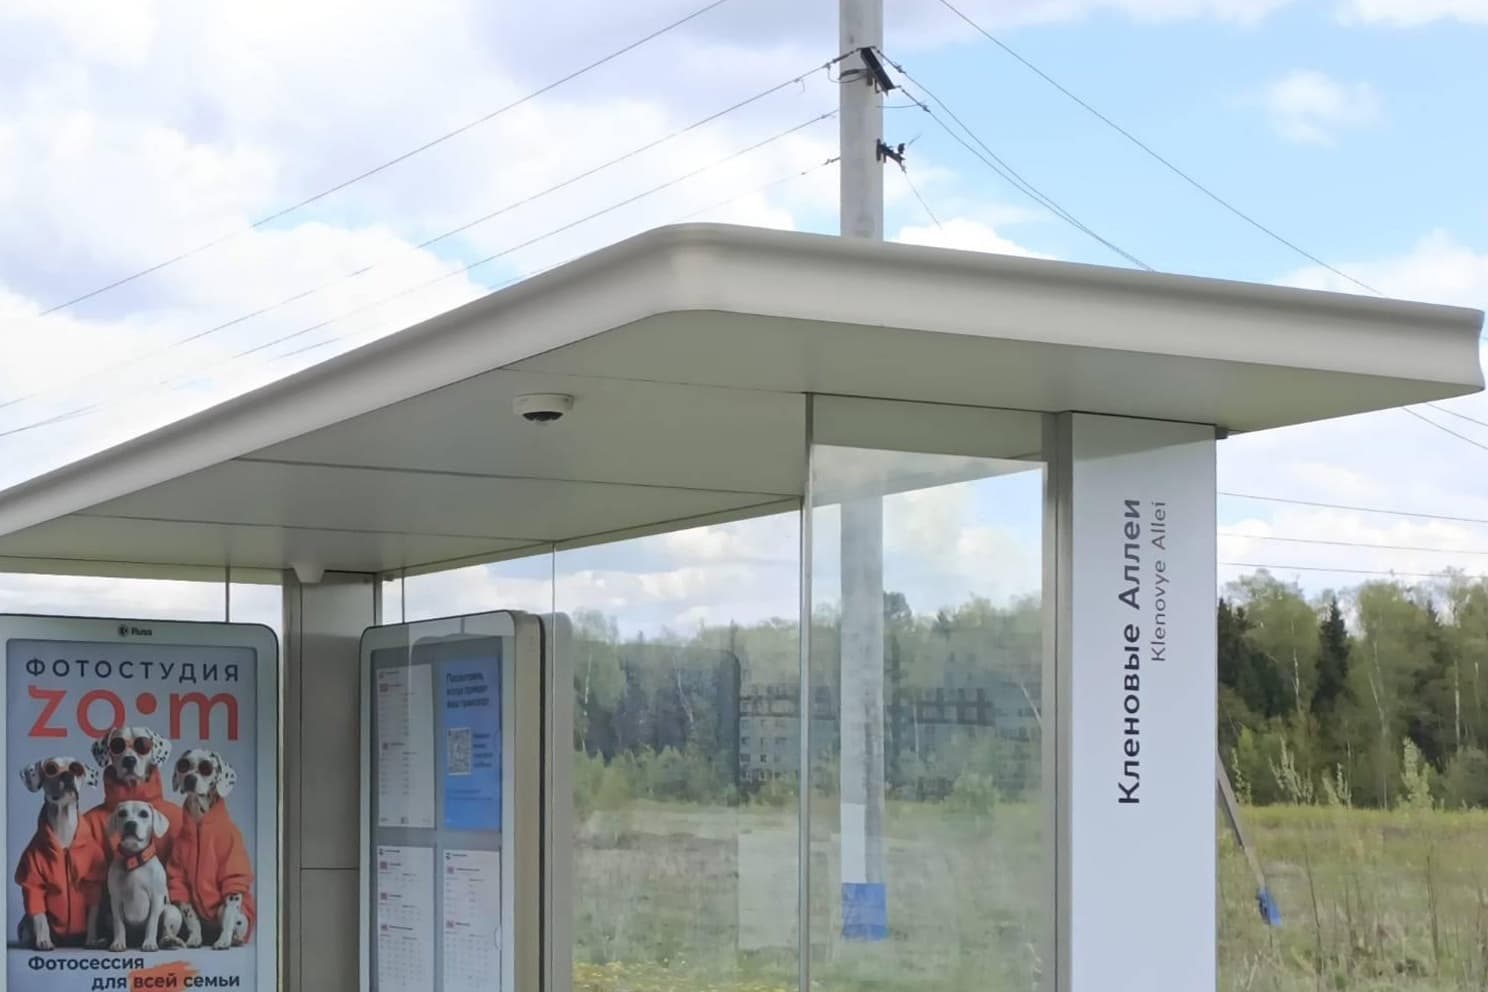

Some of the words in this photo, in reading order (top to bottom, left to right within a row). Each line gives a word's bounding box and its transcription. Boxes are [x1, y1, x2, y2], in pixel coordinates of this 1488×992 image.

[1150, 500, 1166, 551] Allei
[1118, 499, 1141, 610] Аллеи
[1150, 559, 1170, 662] Klenovye
[25, 658, 239, 683] ФОТОСТУДИЯ
[1118, 623, 1141, 804] Кленовые
[27, 956, 145, 971] Фотосессия
[91, 976, 128, 991] для
[133, 972, 177, 989] всей
[183, 975, 240, 989] семьи
